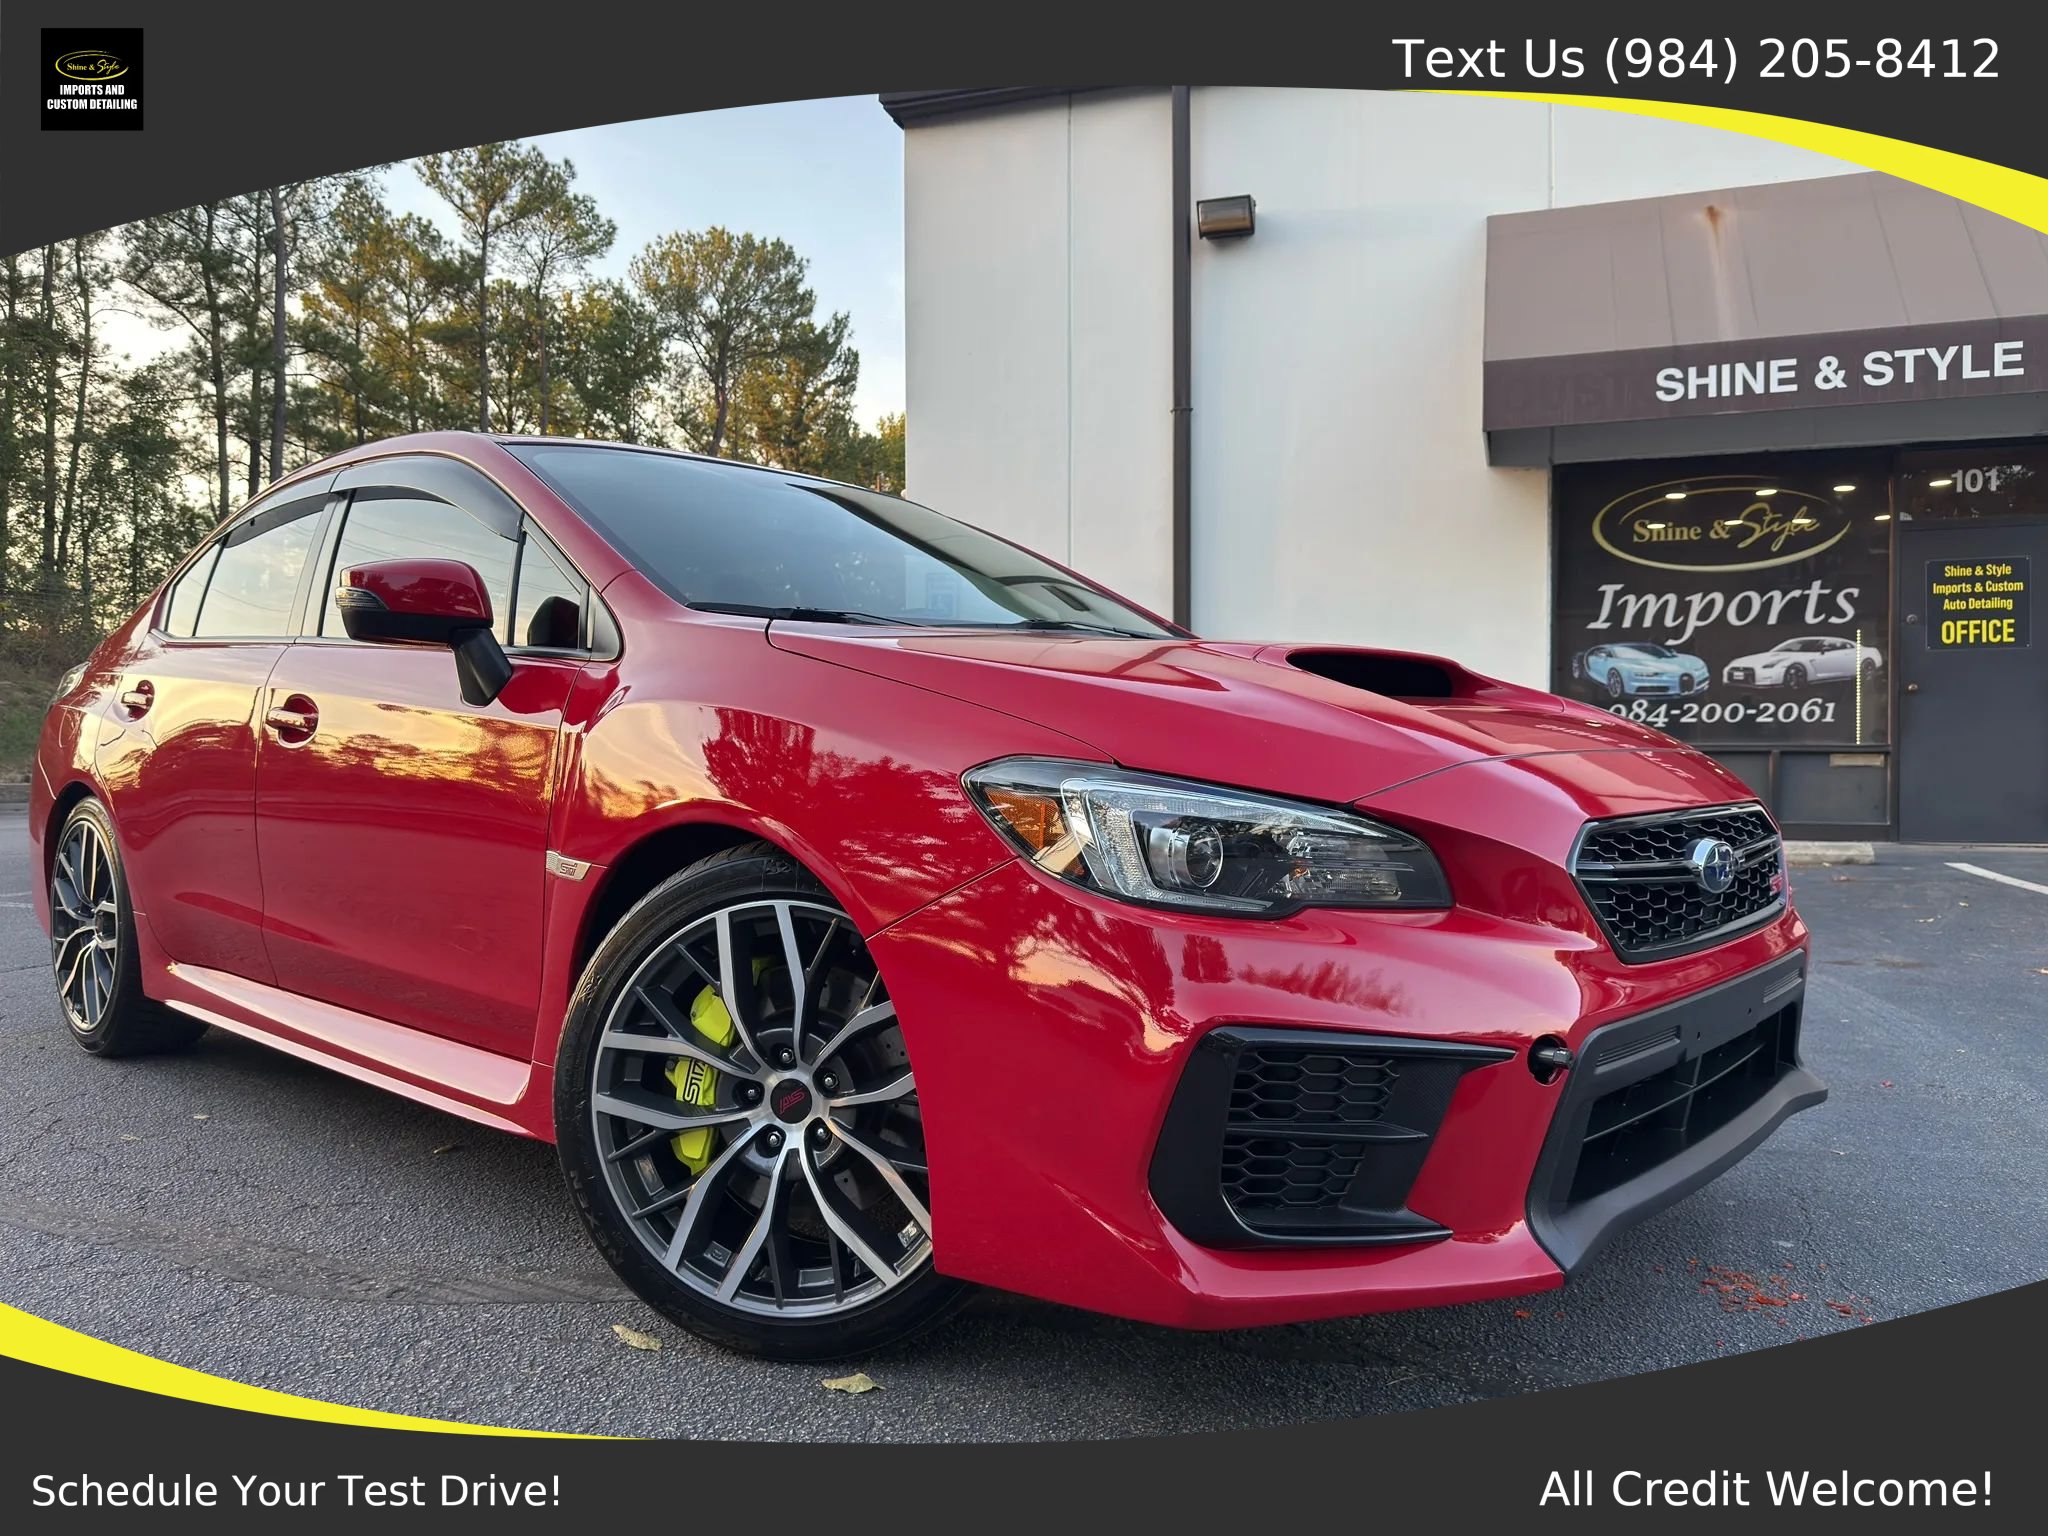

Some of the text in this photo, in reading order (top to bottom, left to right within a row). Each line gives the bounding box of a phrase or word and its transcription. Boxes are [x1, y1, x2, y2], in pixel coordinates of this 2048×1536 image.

[1656, 341, 2024, 401] SHINE & STYLE
[1952, 468, 1999, 493] 101
[1633, 502, 1821, 552] Shine & Style
[1944, 563, 2012, 577] Shine & Style
[1933, 580, 2024, 595] Imports & Custom
[1586, 580, 1860, 646] Imports
[1943, 597, 2014, 611] Auto Detailing
[1941, 619, 2016, 644] OFFICE
